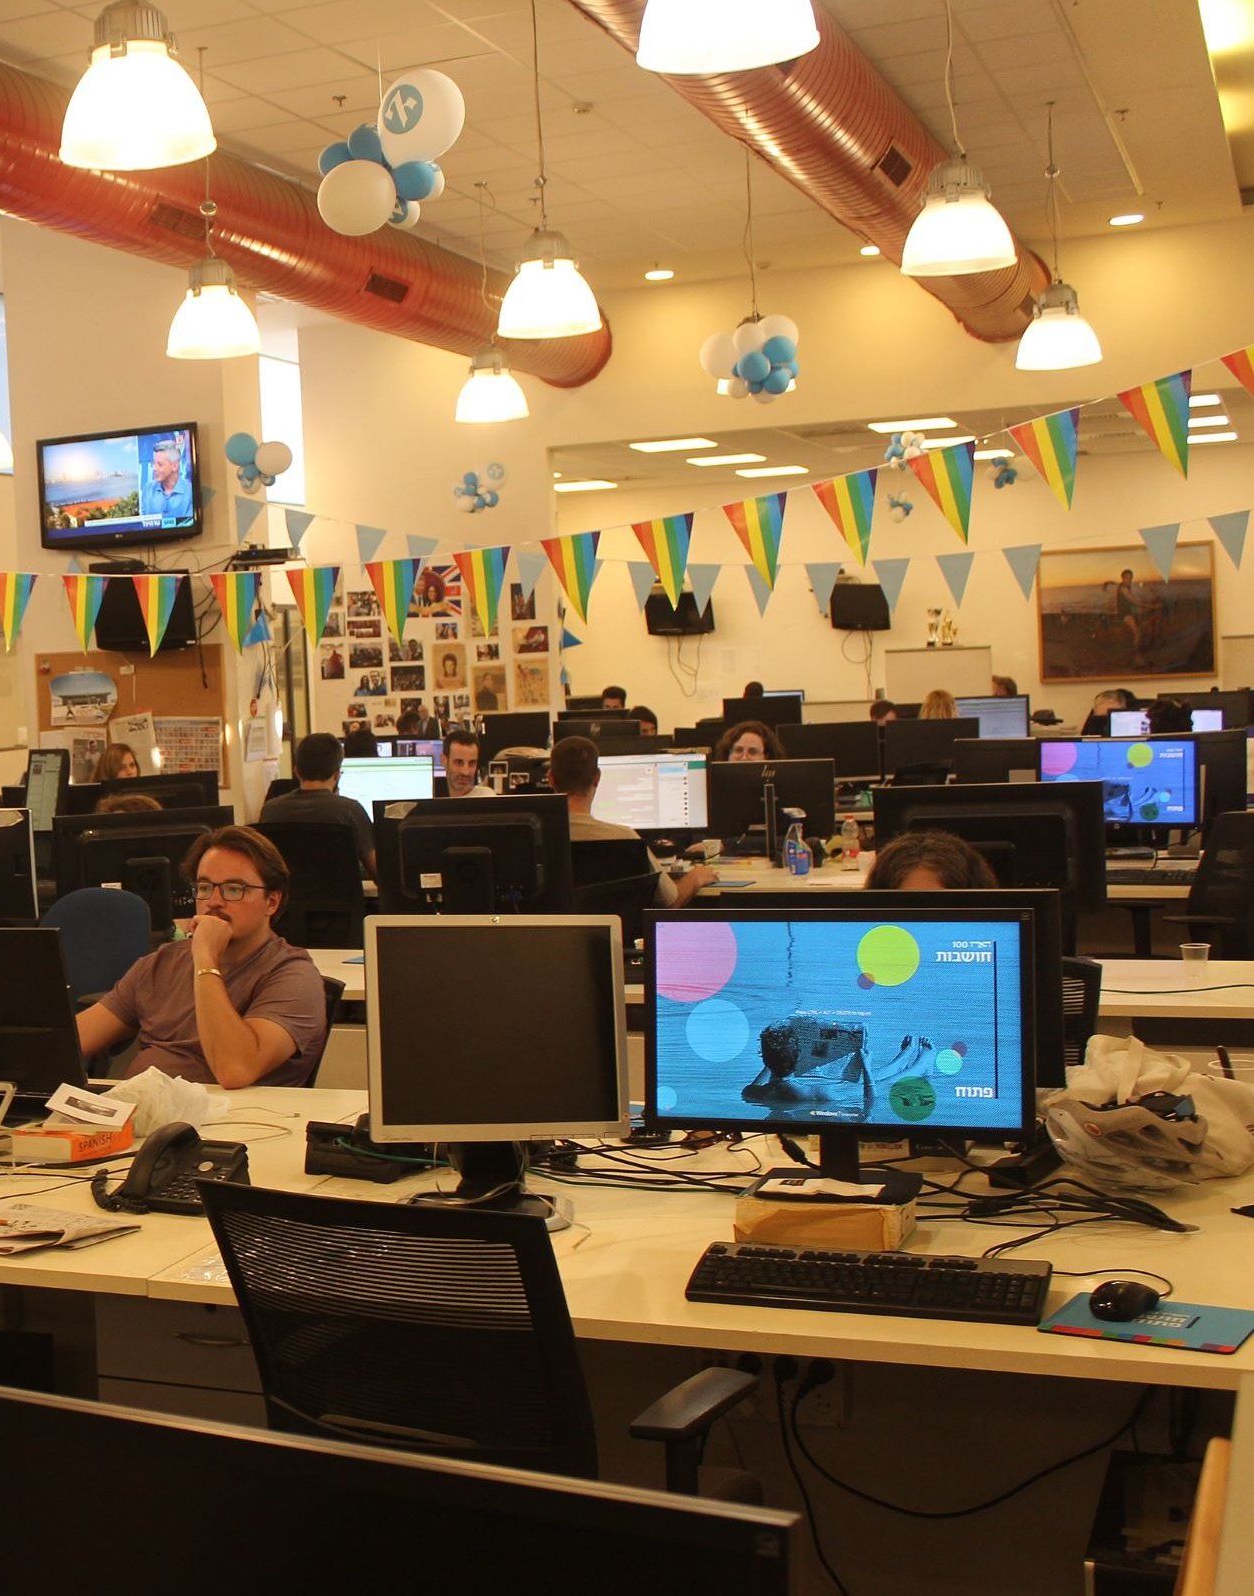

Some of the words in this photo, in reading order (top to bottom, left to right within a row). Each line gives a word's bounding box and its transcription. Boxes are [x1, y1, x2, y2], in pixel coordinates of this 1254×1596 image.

[952, 940, 969, 949] 100
[935, 951, 993, 963] חושבות
[954, 1086, 994, 1098] פתוח
[78, 1133, 113, 1153] SPANISH
